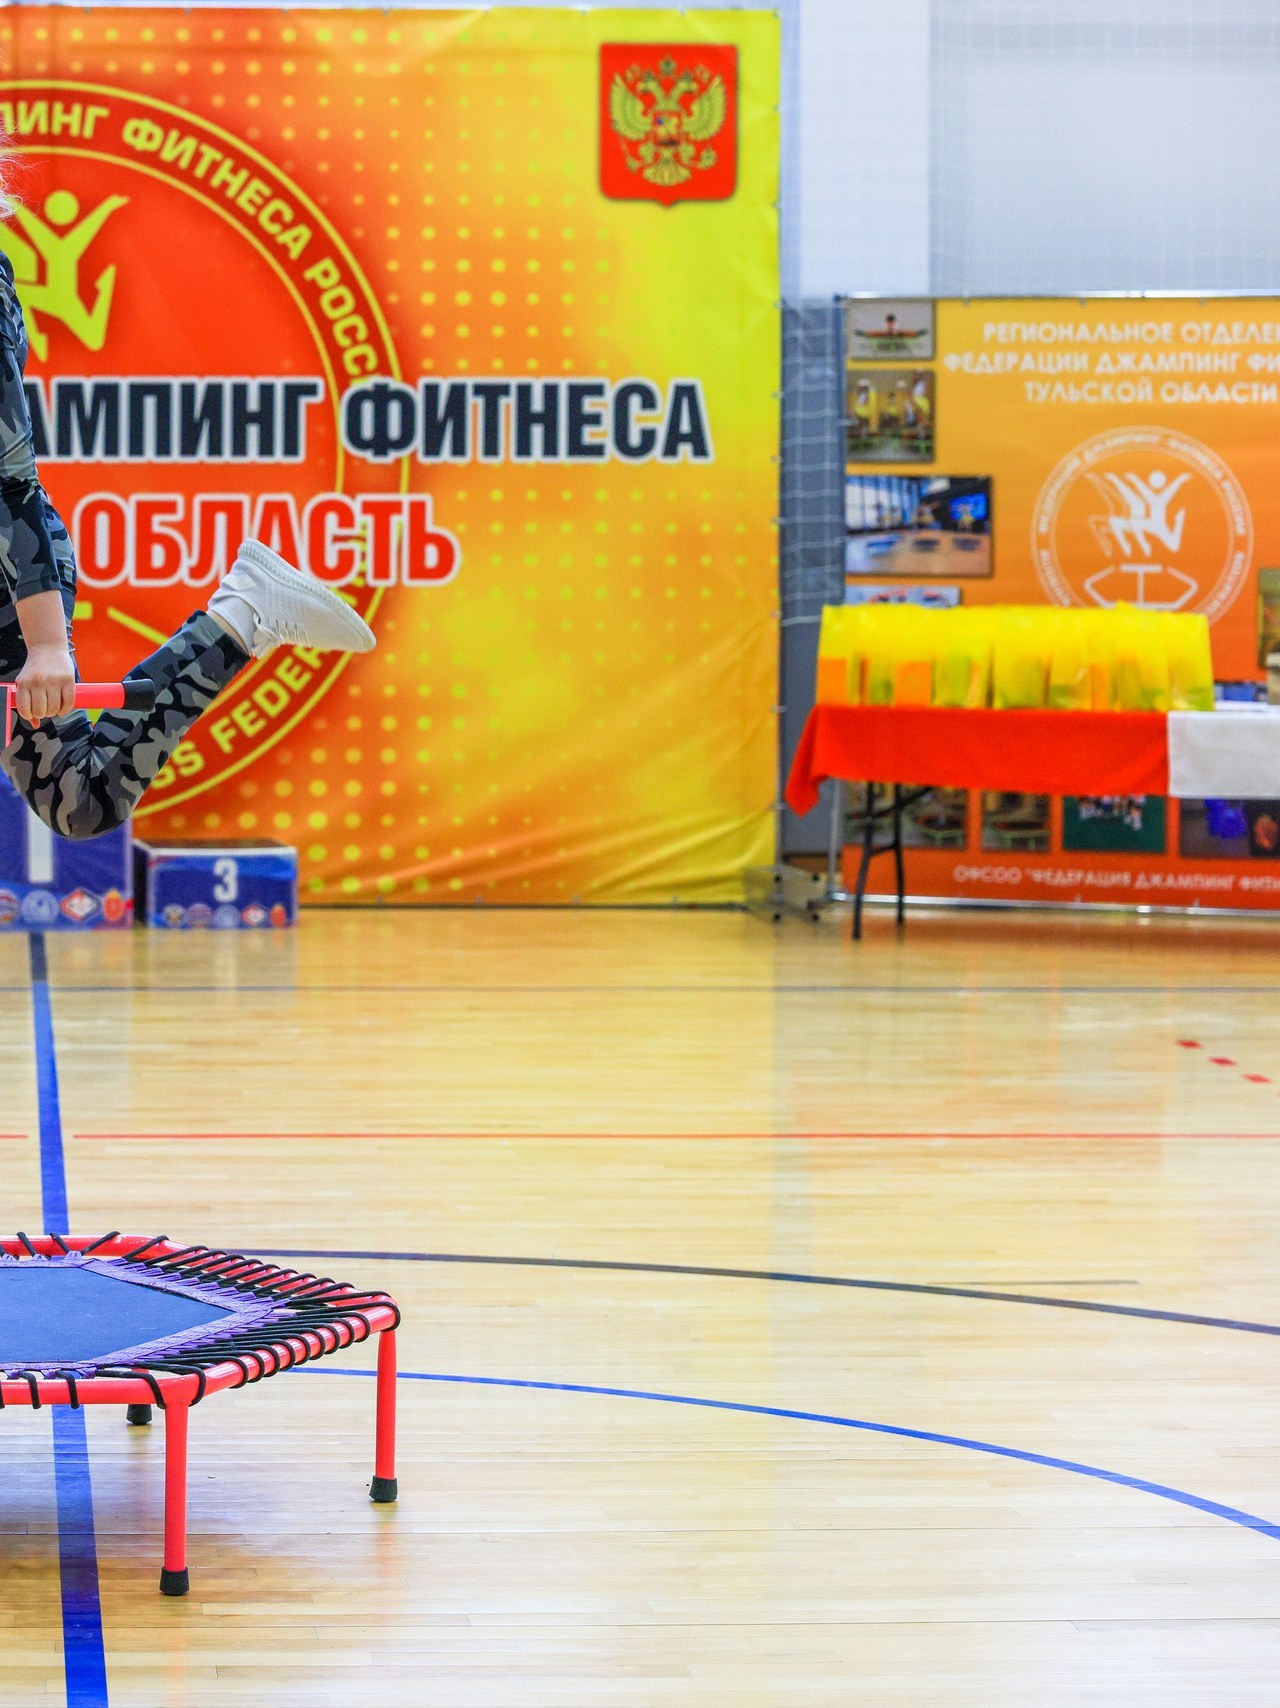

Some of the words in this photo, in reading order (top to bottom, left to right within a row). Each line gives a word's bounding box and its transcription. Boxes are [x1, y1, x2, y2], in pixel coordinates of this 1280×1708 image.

[121, 118, 313, 261] ФИТНЕСА
[983, 321, 1173, 345] РЕГИОНАЛЬНОЕ
[1181, 321, 1280, 347] ОТДЕЛЕ
[944, 352, 1090, 374] ФЕДЕРАЦИИ
[1095, 352, 1238, 374] ДЖАМПИНГ
[1024, 379, 1153, 404] ТУЛЬСКОЙ
[1160, 380, 1279, 405] ОБЛАСТИ
[342, 377, 712, 462] ФИТНЕСА
[73, 493, 460, 588] ОБЛАСТЬ
[213, 858, 239, 903] 3
